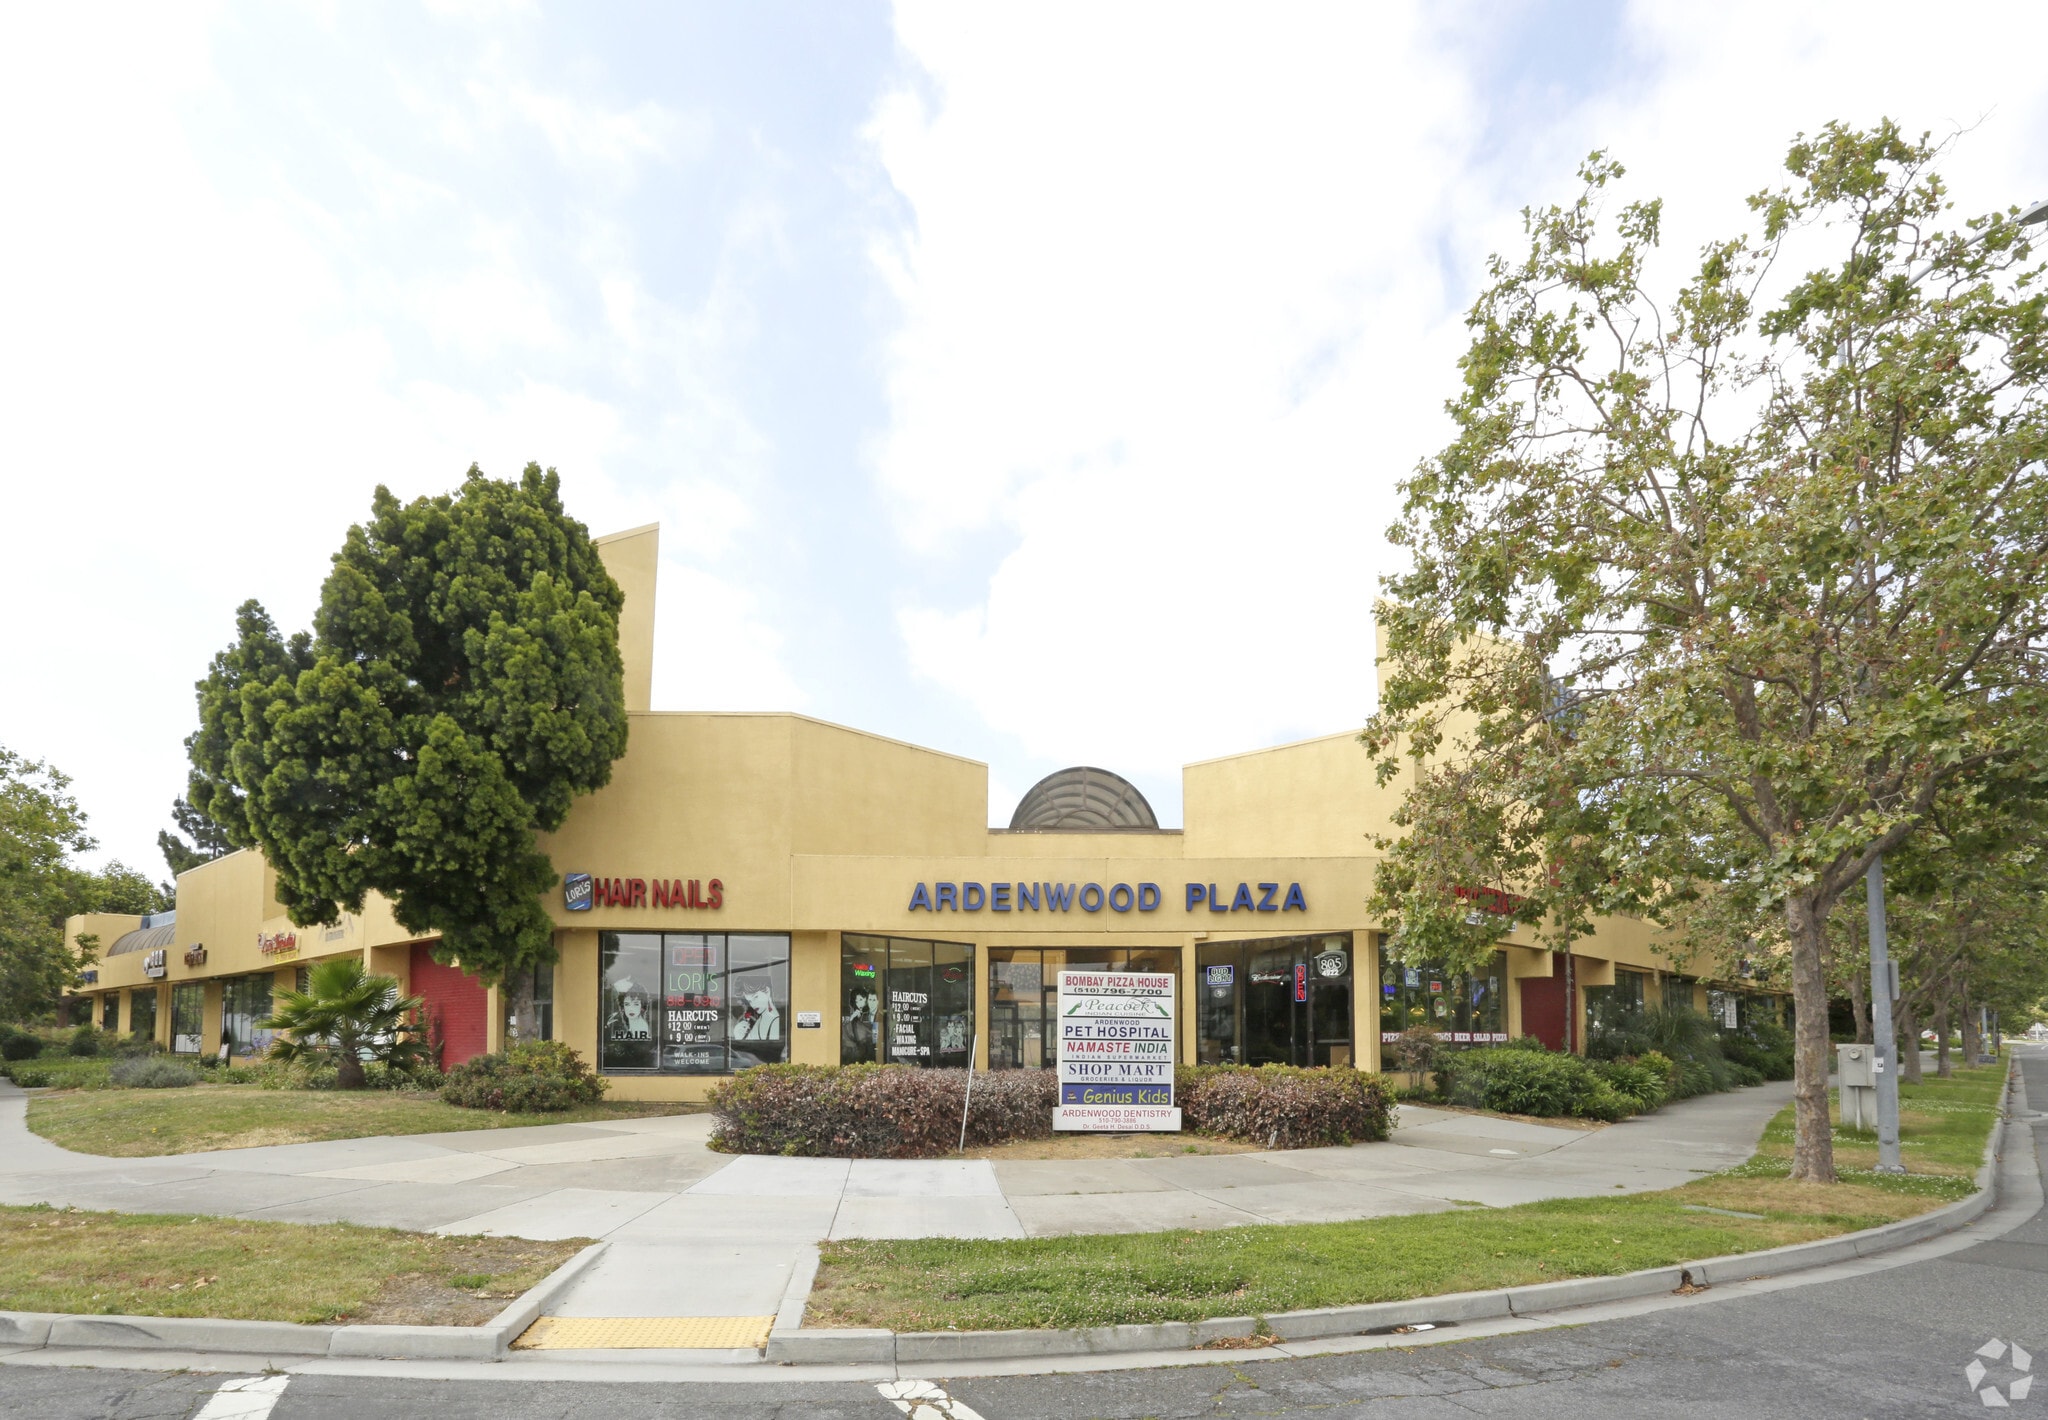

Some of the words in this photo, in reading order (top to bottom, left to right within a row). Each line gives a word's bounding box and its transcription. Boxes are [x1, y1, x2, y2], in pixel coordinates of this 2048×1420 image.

[594, 878, 647, 907] HAIR
[652, 879, 724, 908] NAILS
[908, 882, 1162, 911] ARDENWOOD
[1185, 883, 1307, 911] PLAZA
[1321, 957, 1341, 969] 805
[855, 969, 876, 978] Waxing
[669, 973, 719, 992] LORI'S
[1065, 976, 1104, 986] BOMBAY
[1108, 977, 1135, 987] PIZZA
[1138, 978, 1168, 988] HOUSE
[1296, 965, 1305, 1000] OPEN
[892, 991, 928, 1003] HAIRCUTS
[1085, 997, 1154, 1014] Peacock
[668, 1010, 719, 1021] HAIRCUTS
[615, 1030, 648, 1040] HAIR
[896, 1024, 915, 1034] FACIAL
[1065, 1026, 1093, 1037] PET
[1098, 1027, 1168, 1038] HOSPITAL
[896, 1035, 917, 1044] WAXING
[1454, 1033, 1470, 1041] BEER
[1473, 1033, 1490, 1041] SALAD
[1067, 1042, 1131, 1052] NAMASTE
[1134, 1043, 1168, 1053] INDIA
[1068, 1063, 1112, 1075] SHOP
[1118, 1064, 1165, 1076] MART
[1083, 1088, 1133, 1104] Genius
[1138, 1089, 1169, 1104] Kids
[1062, 1109, 1121, 1117] ARDENWOOD
[1124, 1110, 1172, 1118] DENTISTRY
